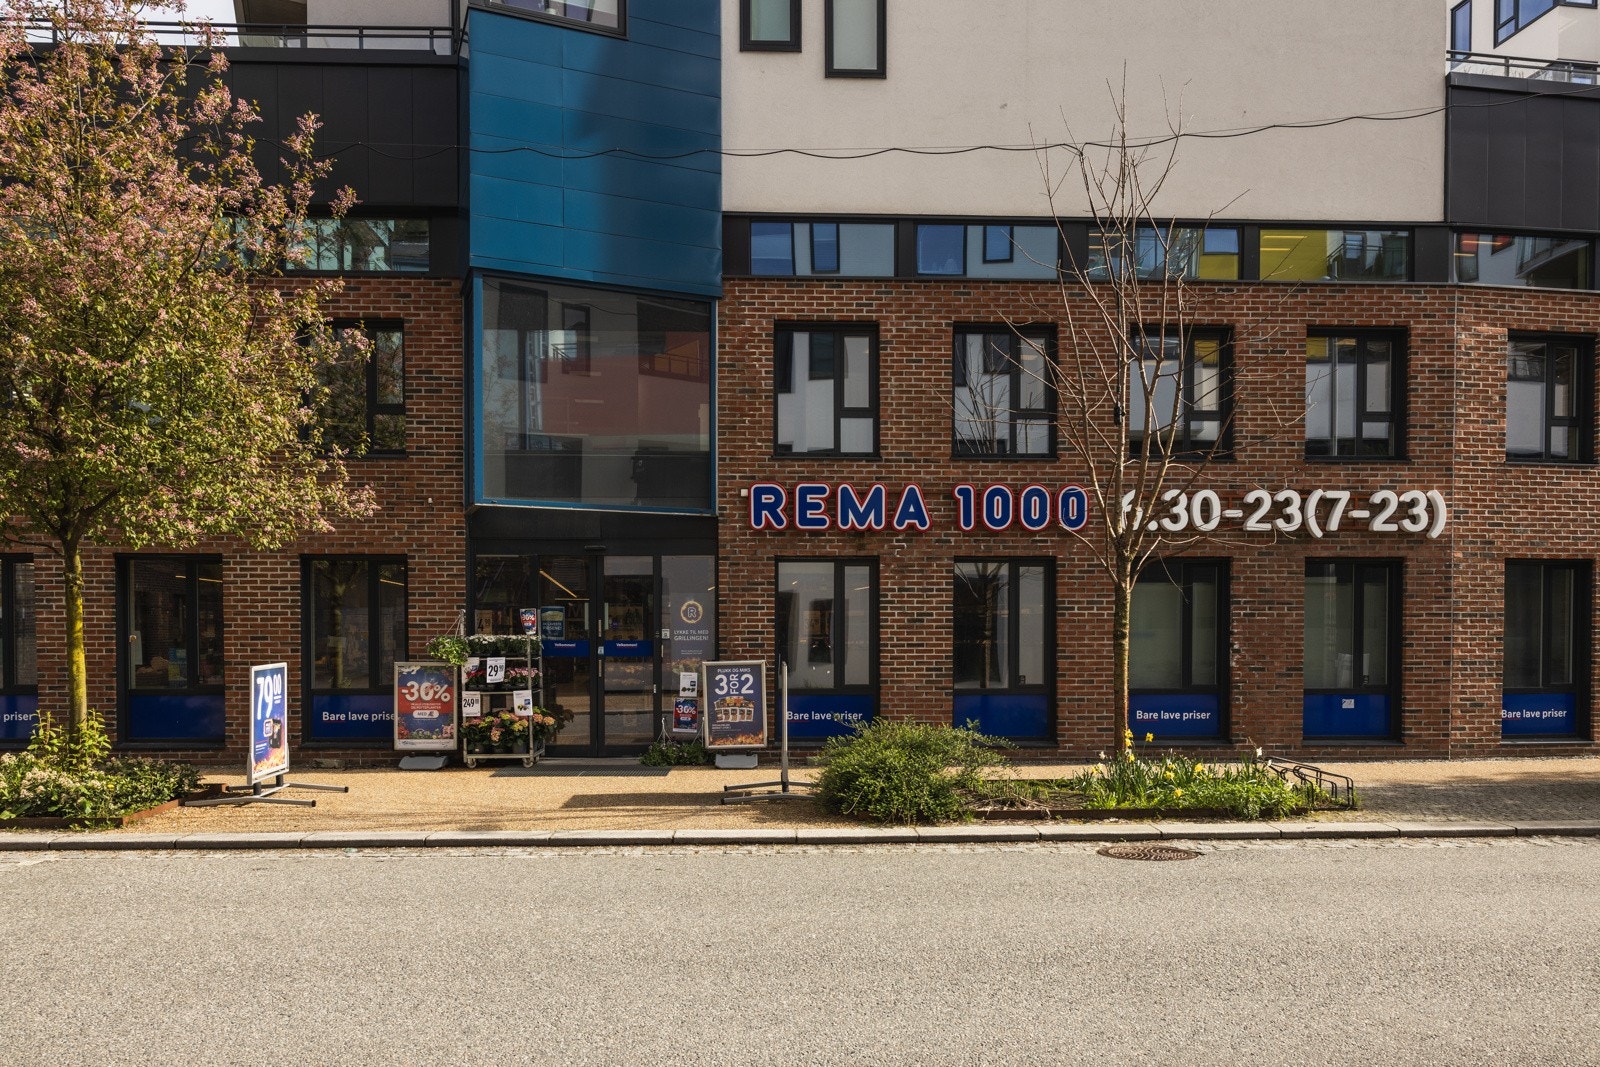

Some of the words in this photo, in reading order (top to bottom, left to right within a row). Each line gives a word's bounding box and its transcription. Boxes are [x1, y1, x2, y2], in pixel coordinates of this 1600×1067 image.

[749, 482, 932, 533] REMA
[952, 483, 1090, 533] 1000
[488, 665, 498, 677] 29
[715, 674, 728, 695] 3
[730, 674, 739, 694] FOR
[741, 674, 754, 694] 2
[402, 681, 450, 702] -30%
[256, 676, 273, 720] 79
[463, 698, 474, 707] 249
[4, 712, 32, 722] priser
[322, 712, 346, 720] Bare
[349, 712, 369, 720] lave
[372, 711, 394, 722] prise
[787, 711, 809, 720] Bare
[812, 711, 831, 720] lave
[1136, 710, 1158, 719] Bare
[1161, 710, 1180, 719] lave
[1183, 710, 1211, 720] priser
[1502, 709, 1520, 718] Bare
[1523, 709, 1540, 718] lave
[1542, 709, 1567, 719] priser
